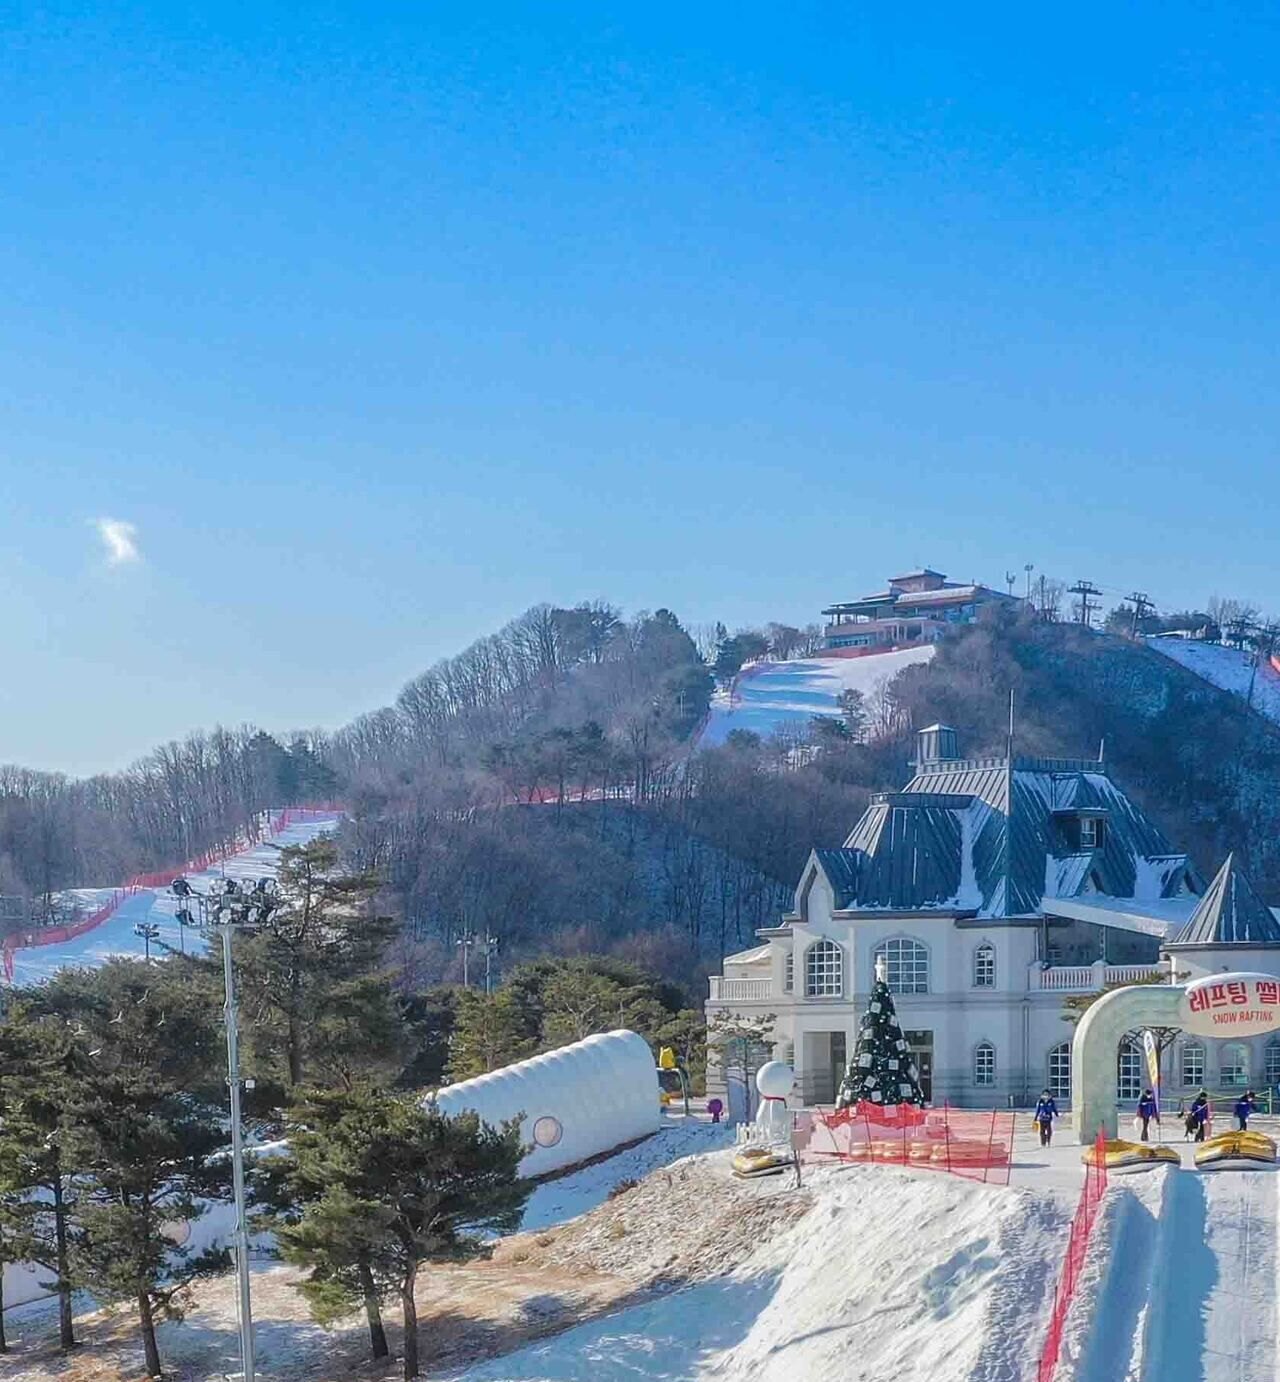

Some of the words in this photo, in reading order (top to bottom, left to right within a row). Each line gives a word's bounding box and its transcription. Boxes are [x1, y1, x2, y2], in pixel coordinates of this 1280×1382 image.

[1189, 981, 1247, 1012] 레프팅
[1212, 1012, 1238, 1024] SNOW
[1239, 1010, 1273, 1022] RAFTING
